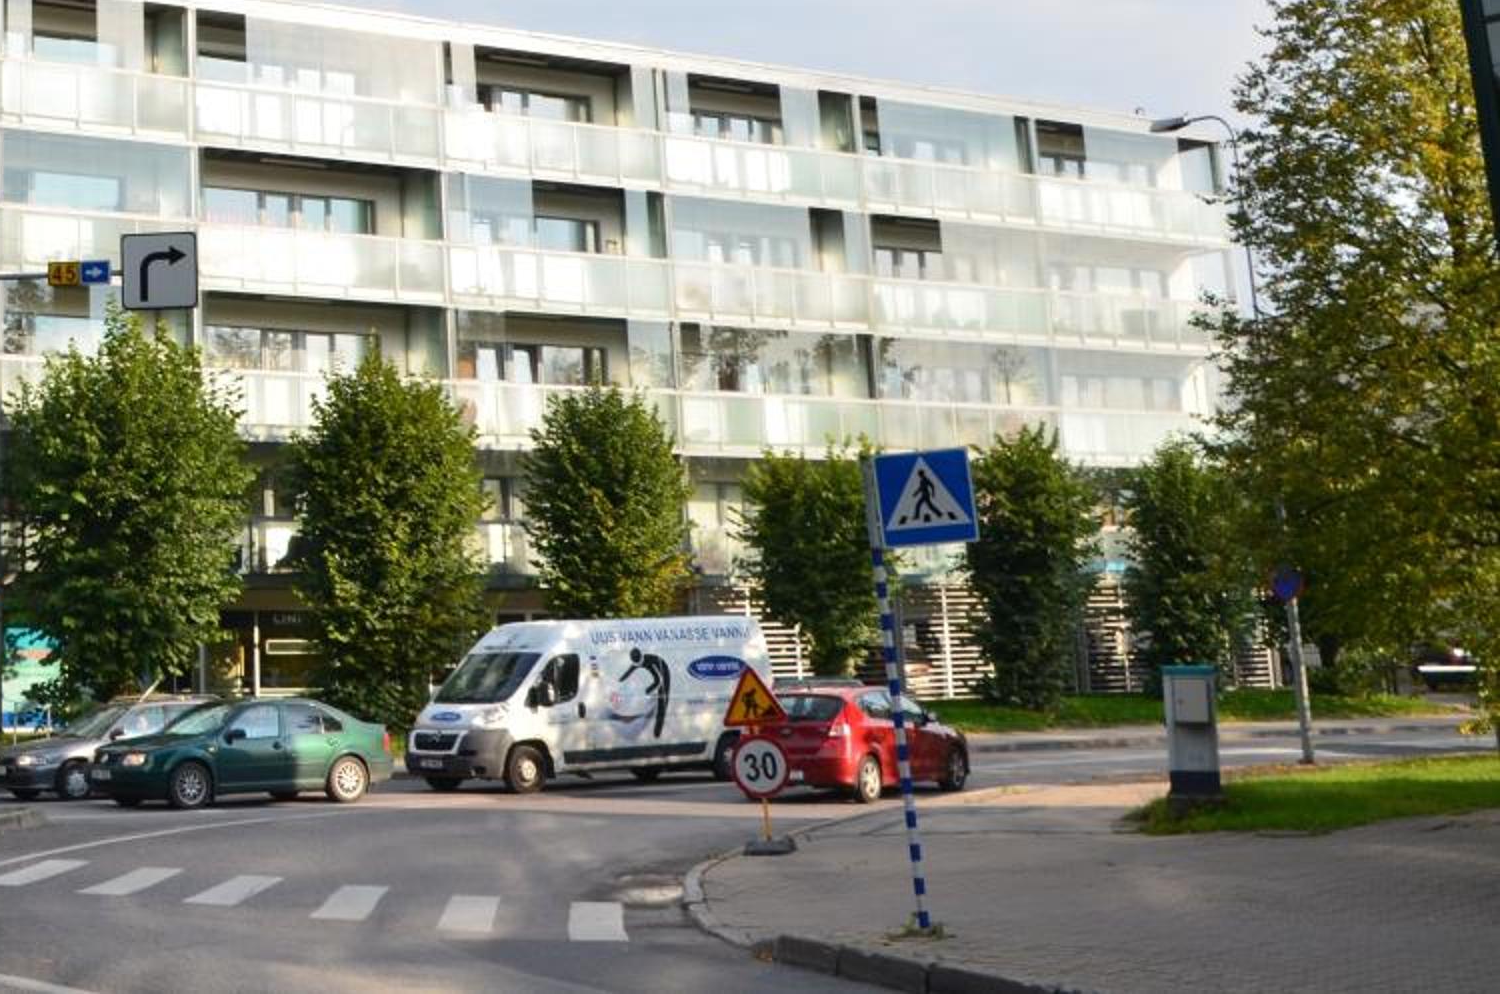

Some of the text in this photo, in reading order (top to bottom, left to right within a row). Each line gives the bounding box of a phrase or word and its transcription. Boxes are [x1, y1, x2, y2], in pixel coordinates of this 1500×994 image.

[52, 267, 77, 283] 45
[591, 630, 617, 645] UUS
[619, 629, 653, 644] VANN
[653, 627, 709, 642] VANASSE
[744, 751, 778, 782] 30
